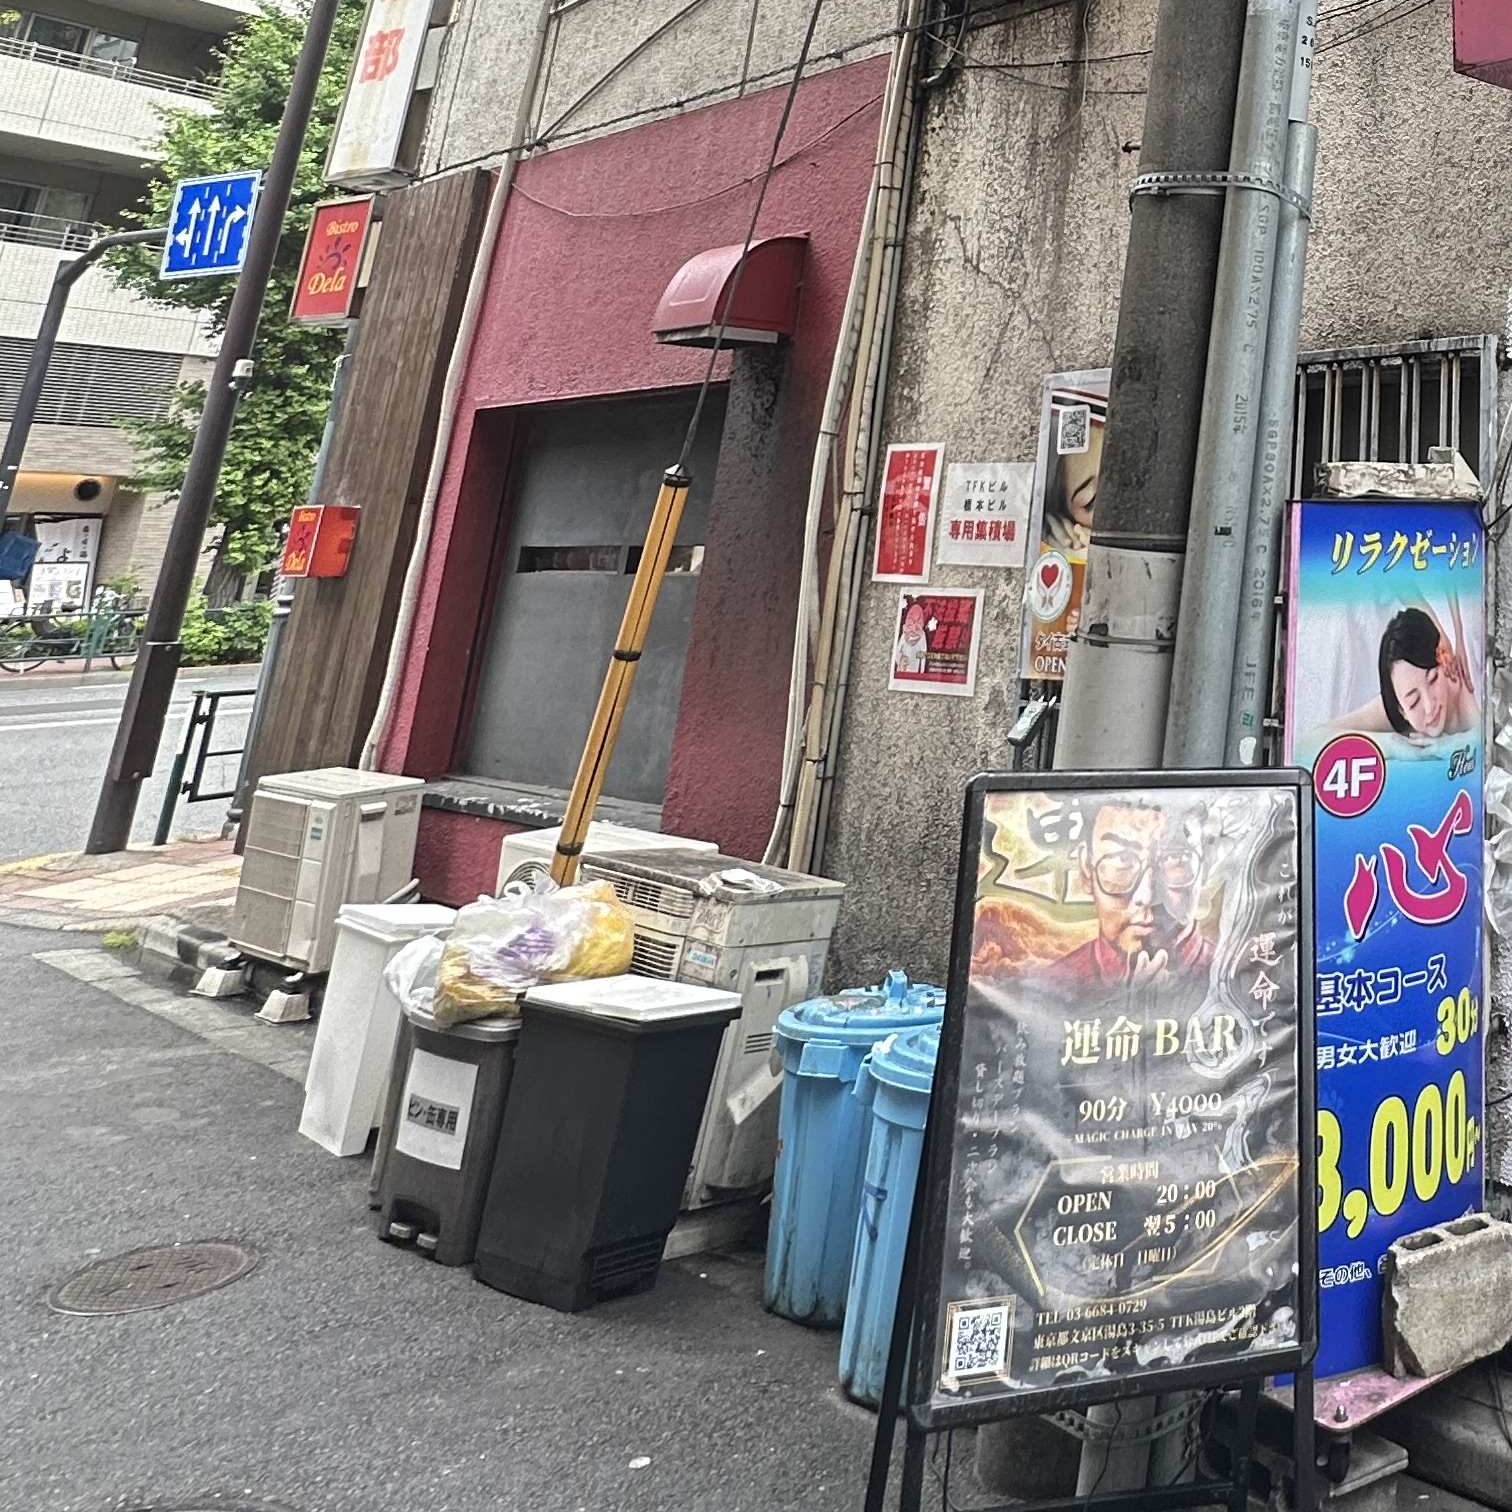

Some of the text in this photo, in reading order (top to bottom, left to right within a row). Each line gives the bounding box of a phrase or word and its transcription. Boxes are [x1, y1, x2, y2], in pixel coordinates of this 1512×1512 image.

[308, 266, 347, 296] Dela
[1330, 530, 1479, 576] リラクゼーション
[1322, 756, 1378, 800] 4F
[1343, 788, 1475, 941] 心
[1316, 953, 1448, 1017] 基本コース
[1060, 1013, 1239, 1067] 運命 BAR
[1317, 1028, 1417, 1070] 男女大歓迎
[1079, 1095, 1128, 1123] 90分
[1100, 1160, 1160, 1185] 営業時間
[1057, 1190, 1113, 1216] OPEN
[1052, 1220, 1118, 1247] CLOSE
